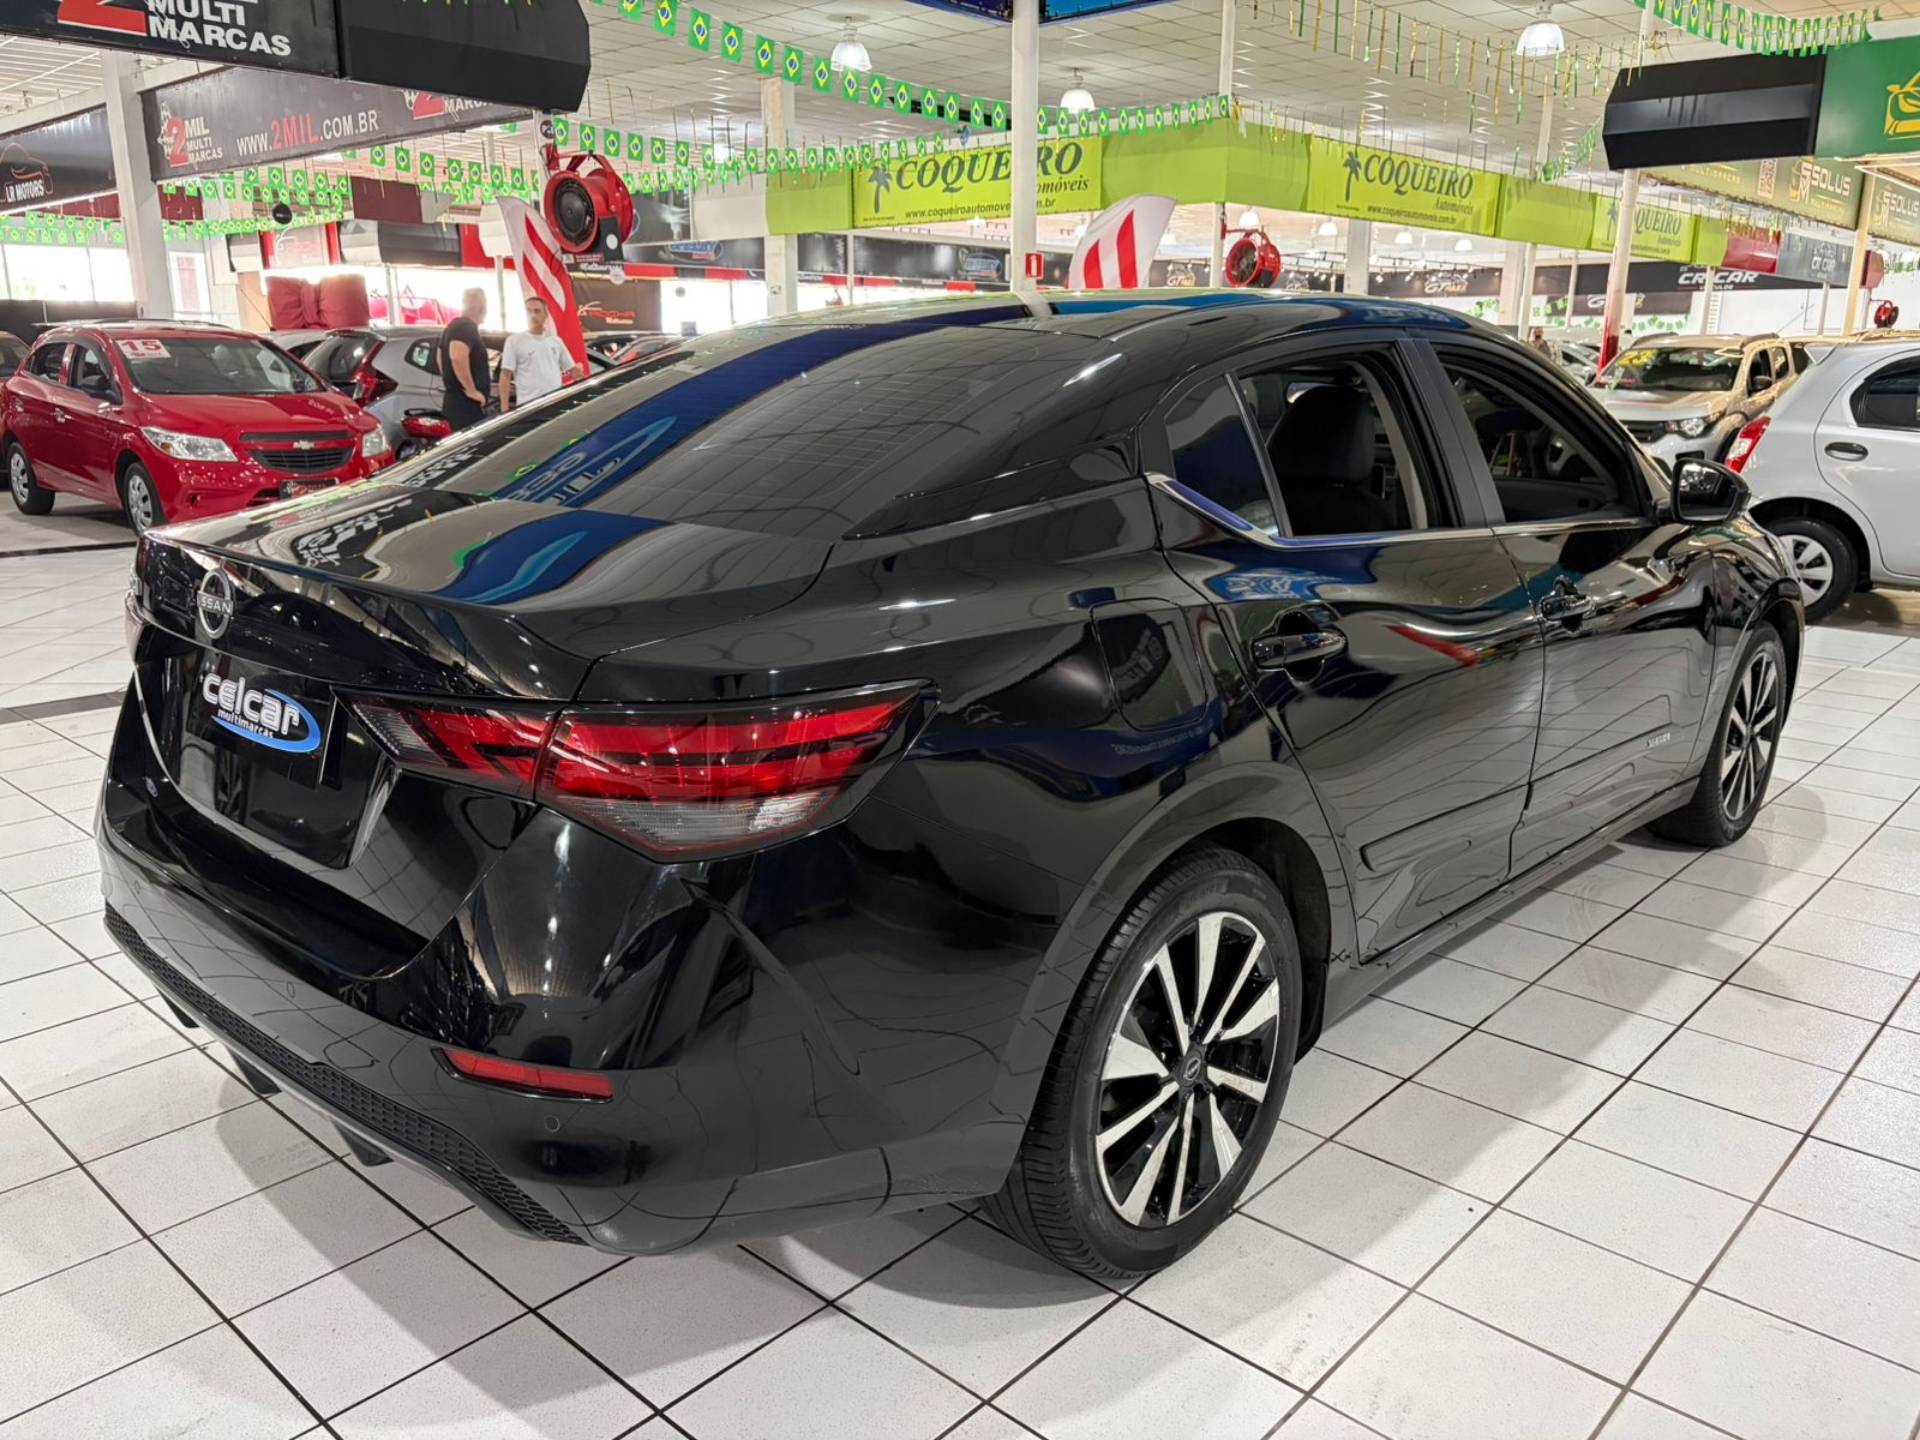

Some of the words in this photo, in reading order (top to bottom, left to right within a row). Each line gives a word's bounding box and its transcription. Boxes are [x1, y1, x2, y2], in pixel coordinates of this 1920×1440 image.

[148, 0, 246, 26] MULTI
[148, 15, 292, 56] MARCAS
[184, 116, 210, 138] MIL
[236, 109, 380, 157] WWW.2MIL.COM.BR
[186, 137, 213, 151] MULTI
[188, 147, 223, 164] MARCAS
[896, 142, 1083, 193] COQUERO
[1364, 153, 1474, 200] COQUEIRO
[1635, 207, 1682, 235] QUEIRO
[121, 340, 162, 351] 15
[203, 673, 300, 735] celcar
[217, 709, 275, 739] multimarcas
